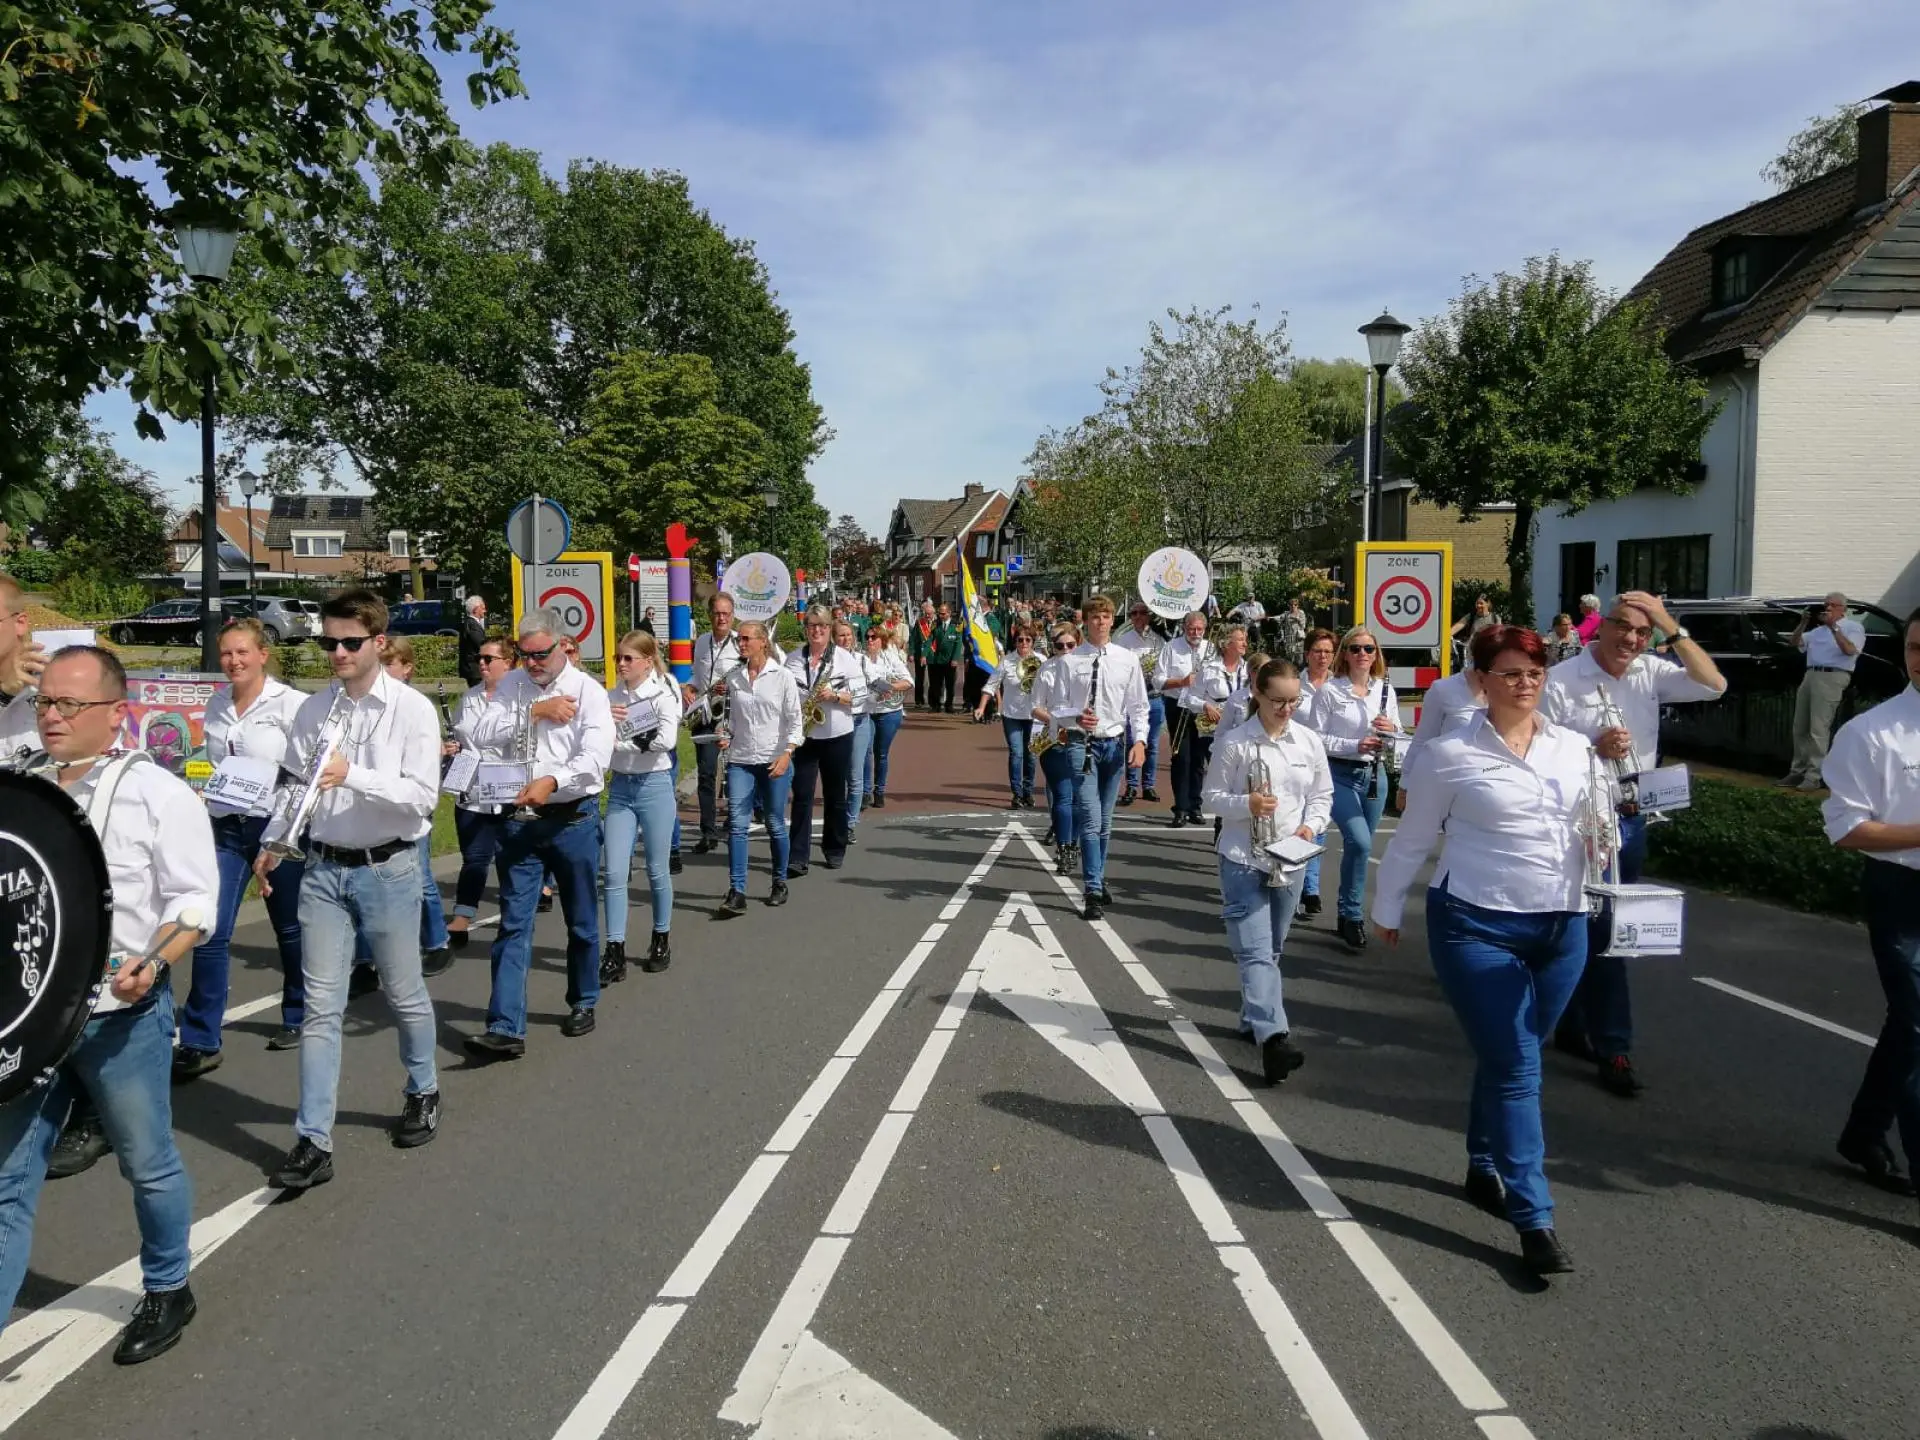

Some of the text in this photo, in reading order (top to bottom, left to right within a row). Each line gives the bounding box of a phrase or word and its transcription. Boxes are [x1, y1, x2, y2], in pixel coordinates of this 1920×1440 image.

[1387, 557, 1420, 567] ZONE
[545, 568, 580, 578] ZONE
[1385, 594, 1421, 615] 30
